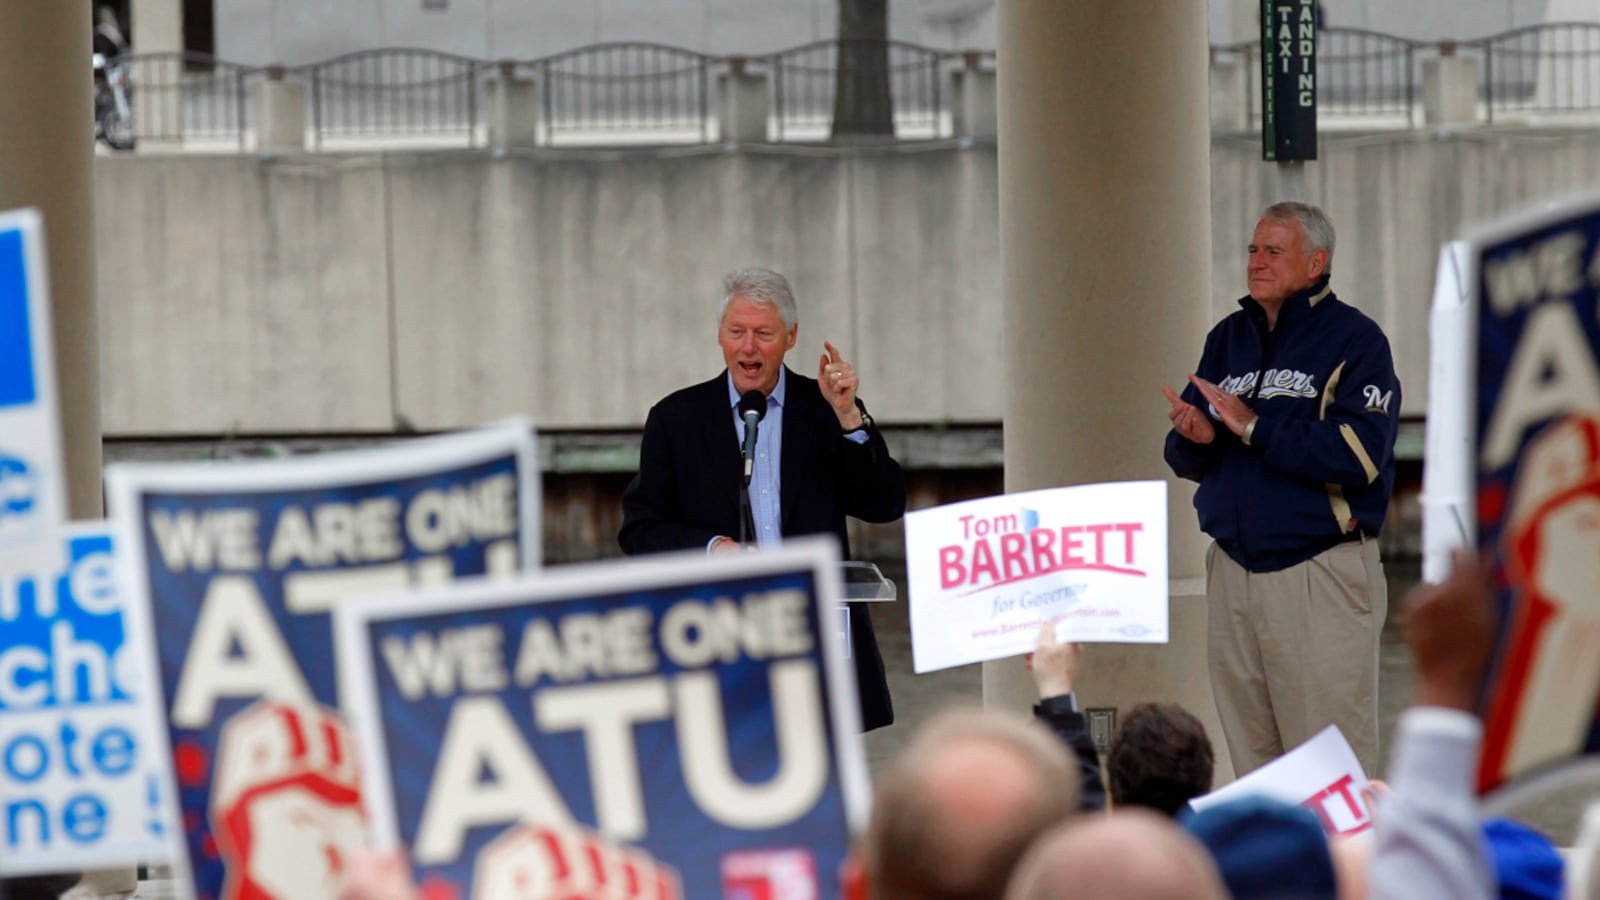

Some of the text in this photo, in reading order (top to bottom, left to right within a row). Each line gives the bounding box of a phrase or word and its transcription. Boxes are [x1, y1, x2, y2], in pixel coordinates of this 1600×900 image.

[1277, 6, 1293, 73] TAXI
[1484, 232, 1587, 317] WE
[1363, 384, 1392, 414] M
[151, 472, 517, 572] WE ARE ONE
[958, 513, 1018, 540] Tom
[939, 523, 1144, 590] BARRETT
[991, 595, 1015, 619] for
[381, 588, 815, 699] WE ARE ONE
[413, 657, 829, 866] ATU
